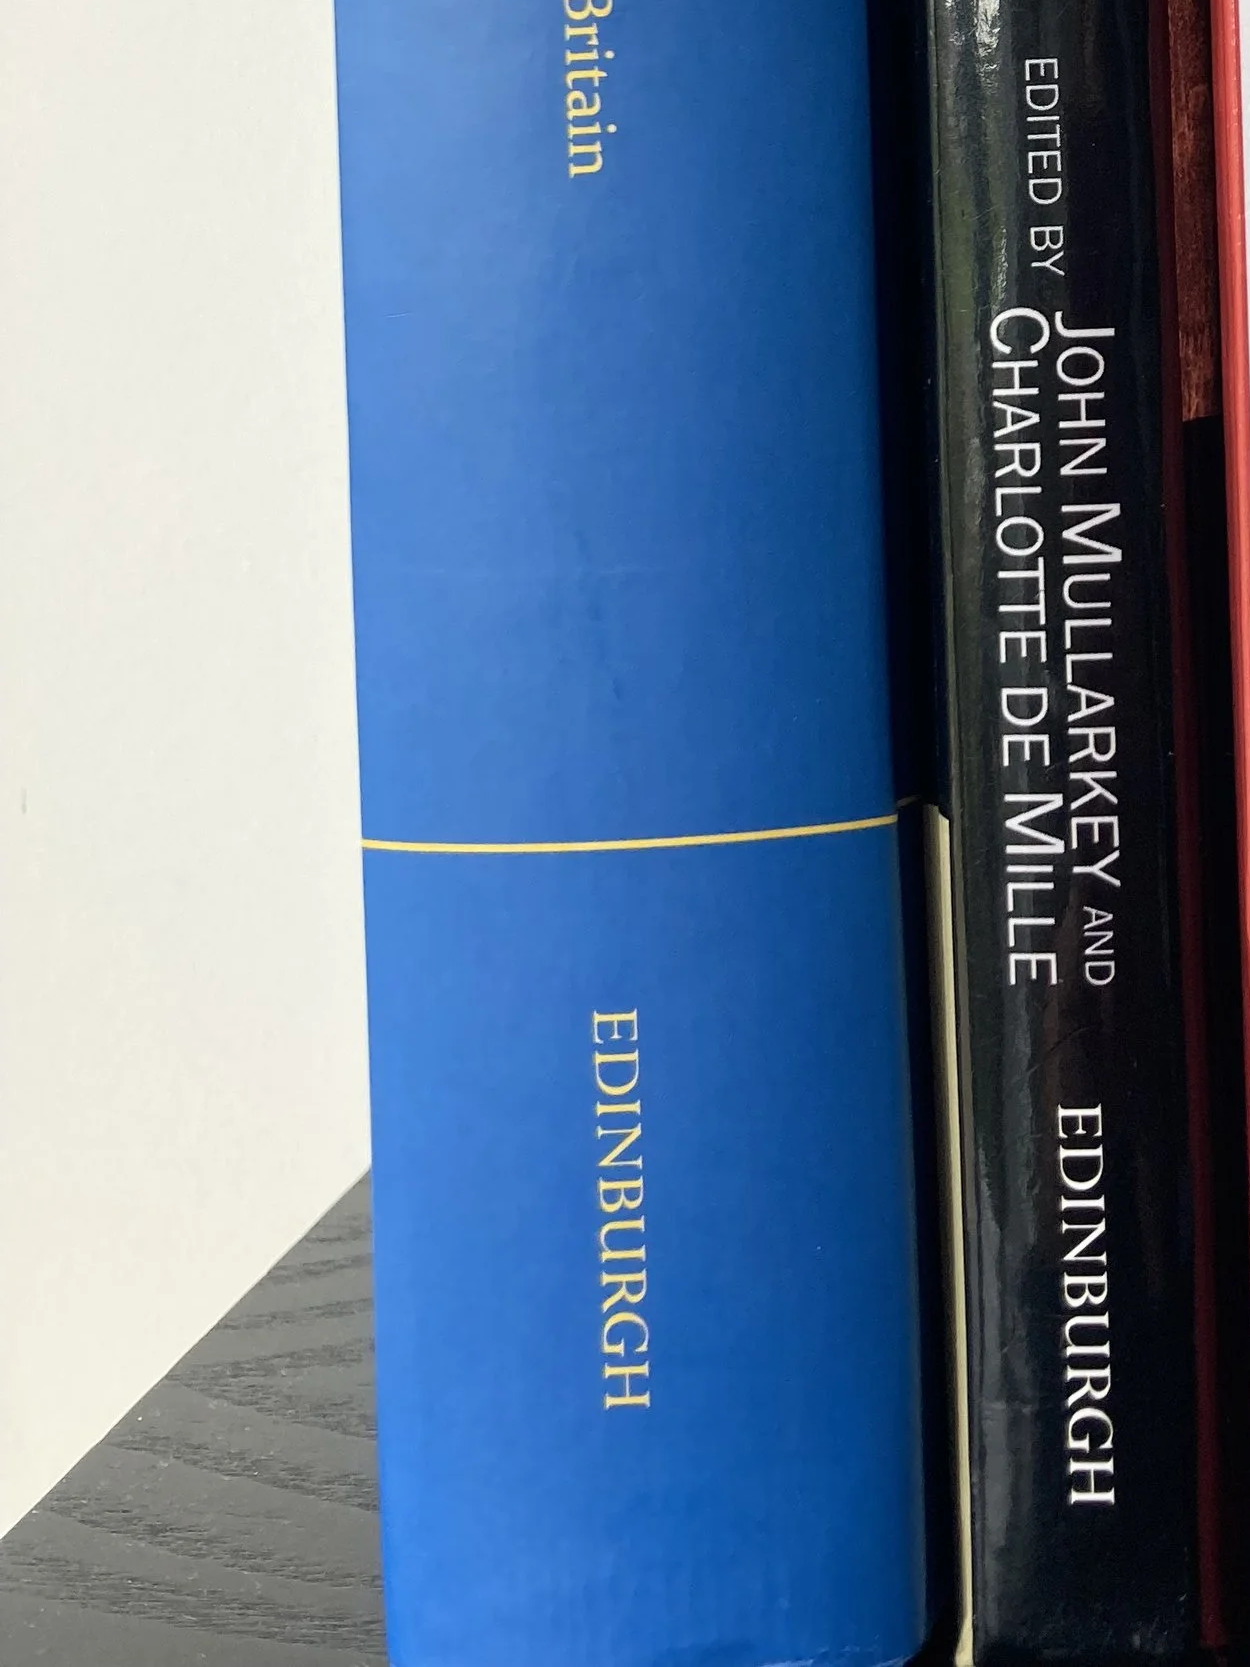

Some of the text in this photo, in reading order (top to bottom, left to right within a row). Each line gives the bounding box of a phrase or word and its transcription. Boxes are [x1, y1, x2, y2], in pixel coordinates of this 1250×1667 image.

[1024, 58, 1065, 276] EDITED BY
[989, 307, 1065, 986] CHARLOTTE DE MILLE
[1054, 310, 1123, 986] JOHN MULLARKEY AND
[591, 1010, 650, 1409] EDINBURGH
[1057, 1103, 1115, 1505] EDINBURGH
